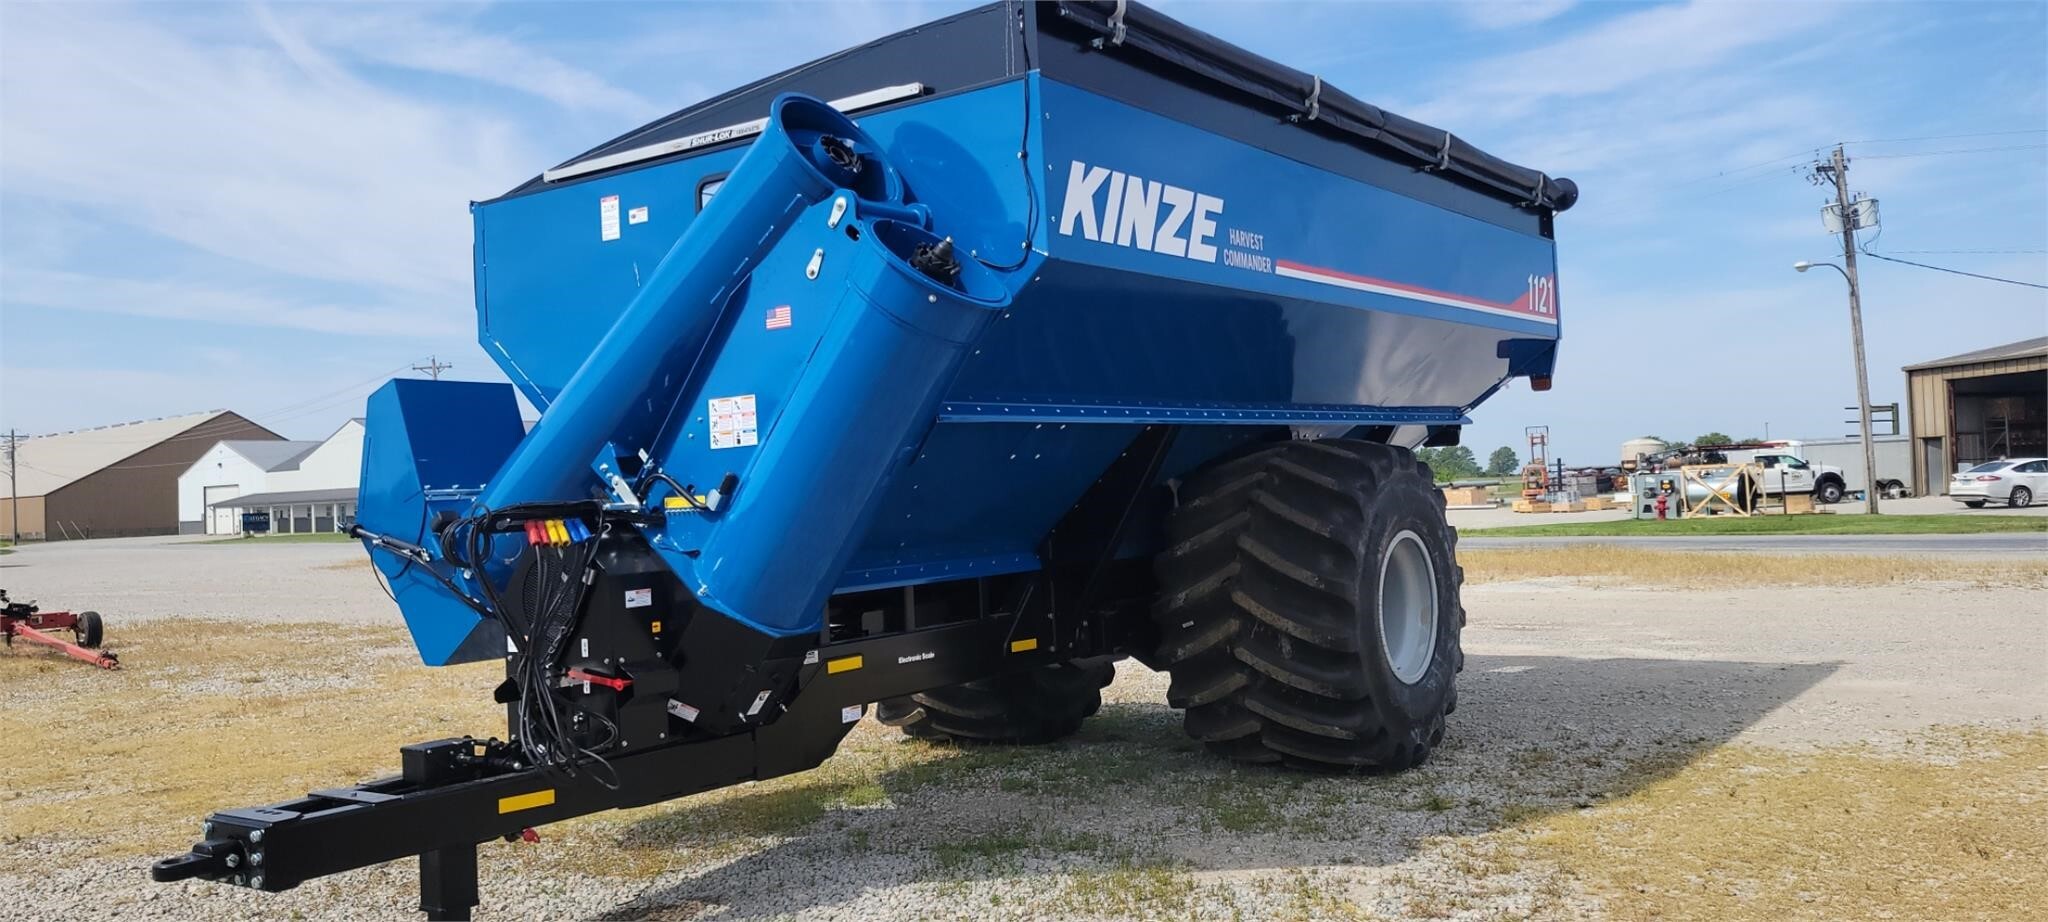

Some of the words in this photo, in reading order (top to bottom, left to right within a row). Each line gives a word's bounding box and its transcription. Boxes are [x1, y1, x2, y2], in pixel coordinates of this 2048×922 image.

[1059, 160, 1225, 263] KINZE
[1229, 227, 1264, 251] HARVEST
[1223, 248, 1272, 273] COMMANDER
[1527, 273, 1553, 315] 1121
